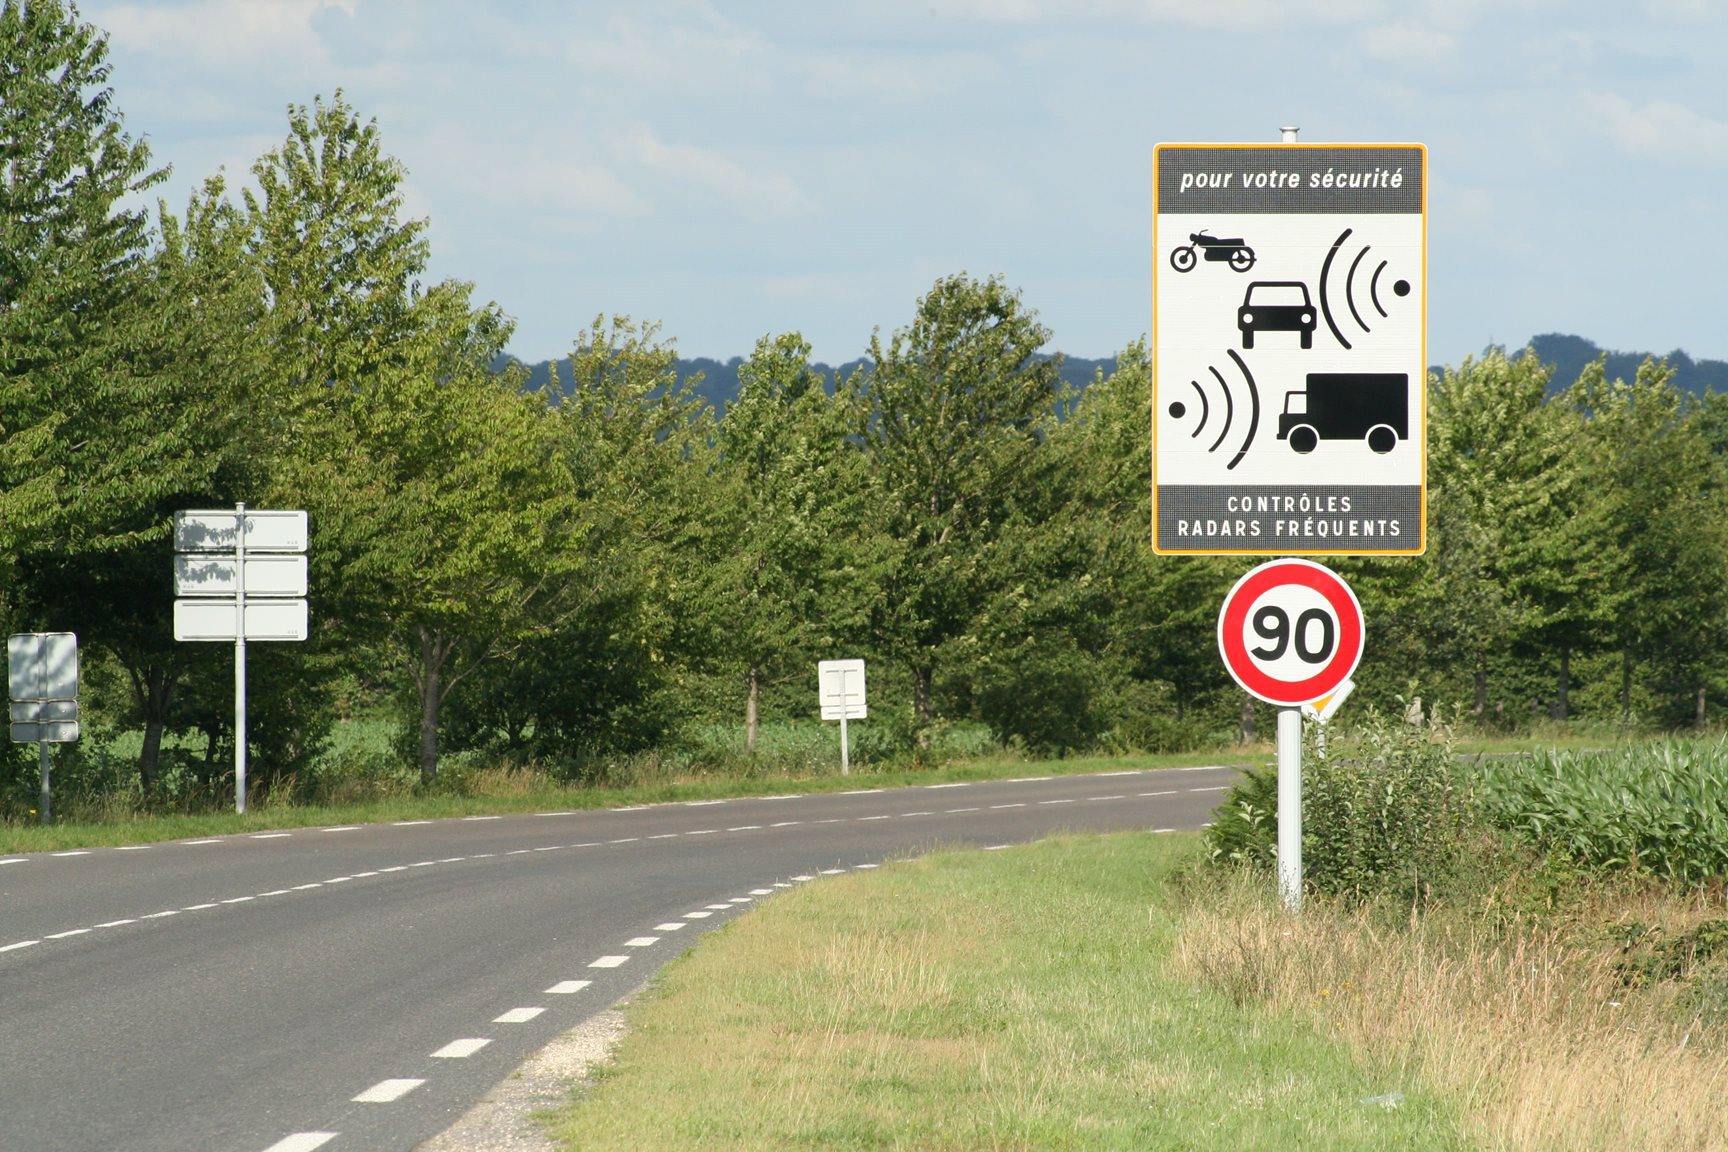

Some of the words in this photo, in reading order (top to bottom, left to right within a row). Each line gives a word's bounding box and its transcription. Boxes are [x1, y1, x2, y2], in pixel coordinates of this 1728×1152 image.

[1180, 171, 1233, 193] pour
[1242, 170, 1300, 188] votre
[1309, 167, 1403, 188] sécurité
[1227, 492, 1351, 512] CONTRÔLES
[1178, 520, 1261, 537] RADARS
[1276, 516, 1400, 538] FRÉQUENTS
[1250, 605, 1335, 664] 90
